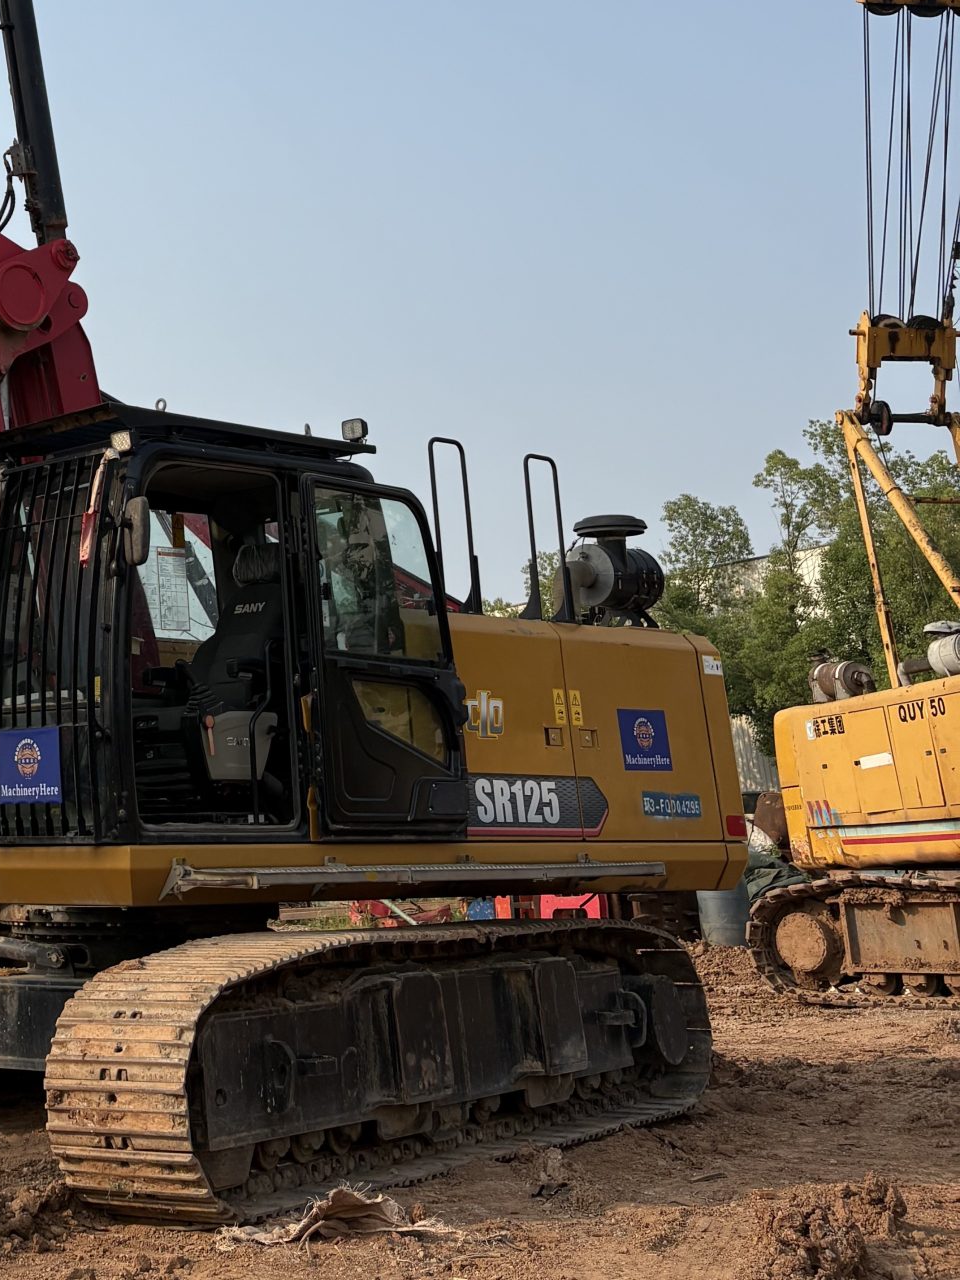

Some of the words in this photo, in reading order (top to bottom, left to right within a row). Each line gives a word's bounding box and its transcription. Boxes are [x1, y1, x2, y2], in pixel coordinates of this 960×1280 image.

[233, 601, 266, 614] SANY
[898, 700, 924, 723] QUY
[930, 697, 945, 717] 50
[625, 754, 670, 767] MachineryHere
[1, 783, 59, 800] MachineryHere
[474, 778, 560, 824] SR125
